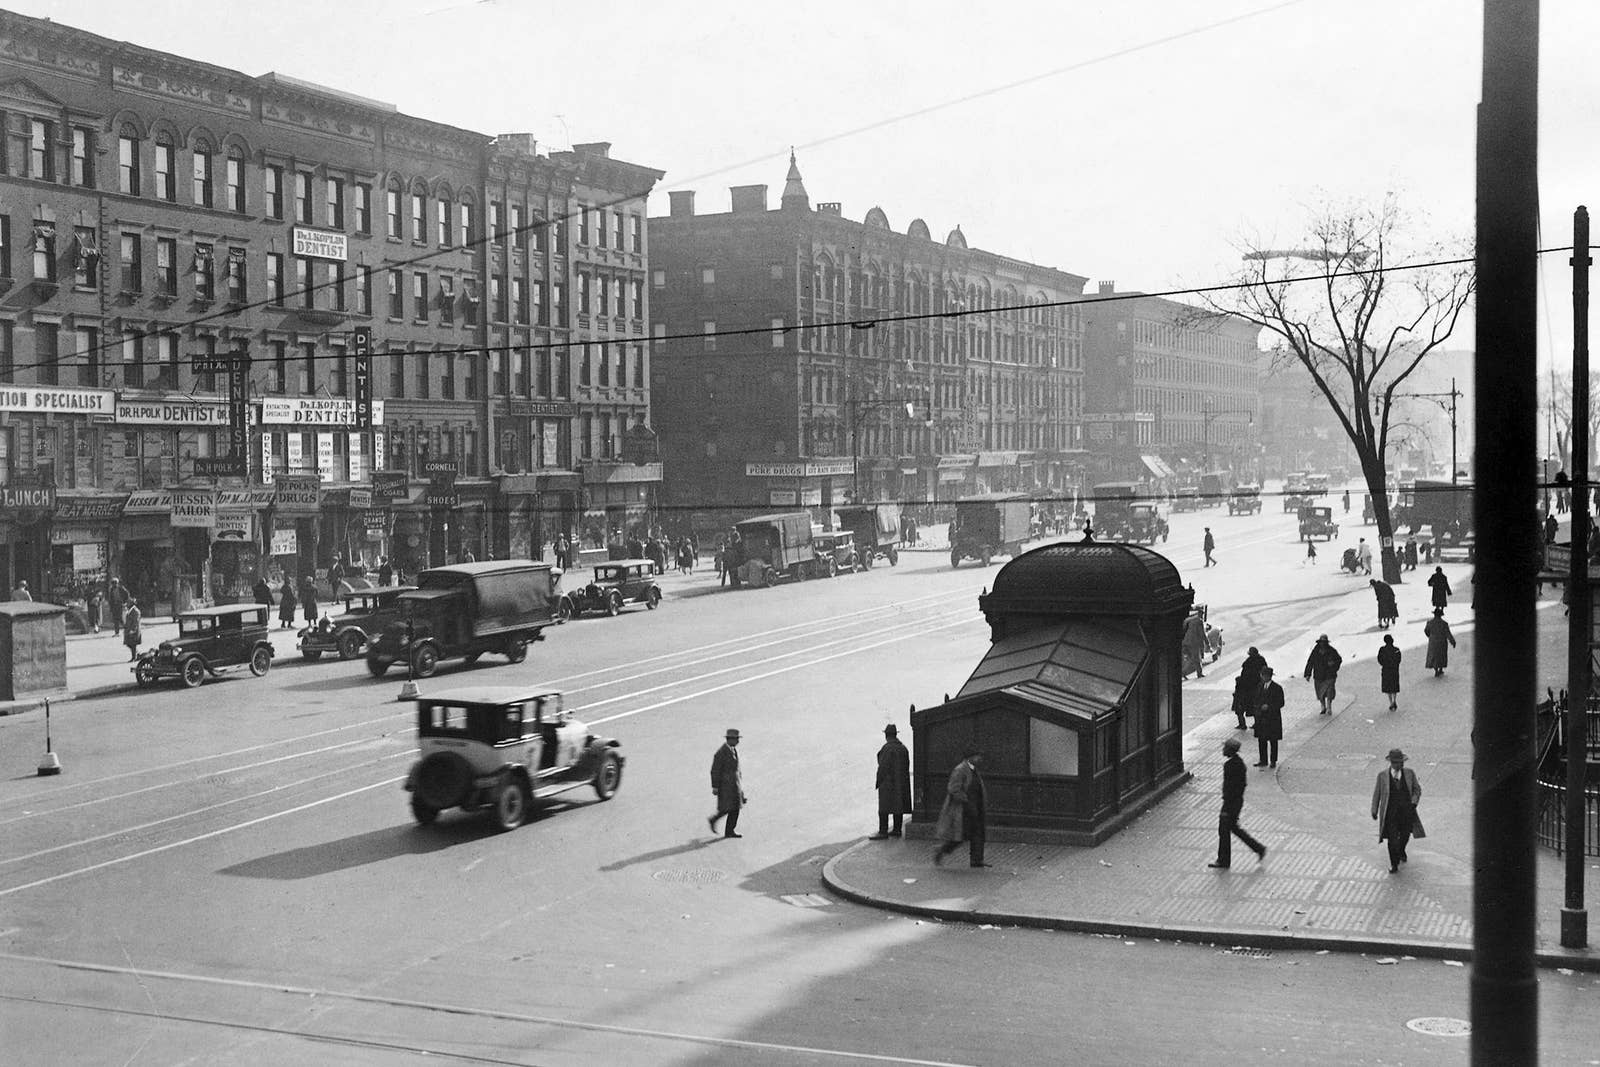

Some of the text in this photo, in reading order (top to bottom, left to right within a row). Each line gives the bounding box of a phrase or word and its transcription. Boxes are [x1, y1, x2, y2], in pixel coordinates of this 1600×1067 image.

[297, 241, 344, 258] DENTIST
[356, 334, 367, 428] DENTIST
[35, 393, 103, 409] SPECIALIST
[233, 358, 241, 457] DENTIST
[164, 406, 215, 422] DENTIST
[295, 410, 356, 422] DENTIST
[425, 463, 457, 471] CORNELL
[3, 489, 49, 507] LUNCH
[173, 494, 214, 505] HESSEN
[279, 493, 317, 503] DRUGS
[427, 496, 456, 505] SHOES
[83, 502, 122, 517] MARKET
[174, 505, 211, 516] TAILOR
[216, 522, 248, 530] DENTIST
